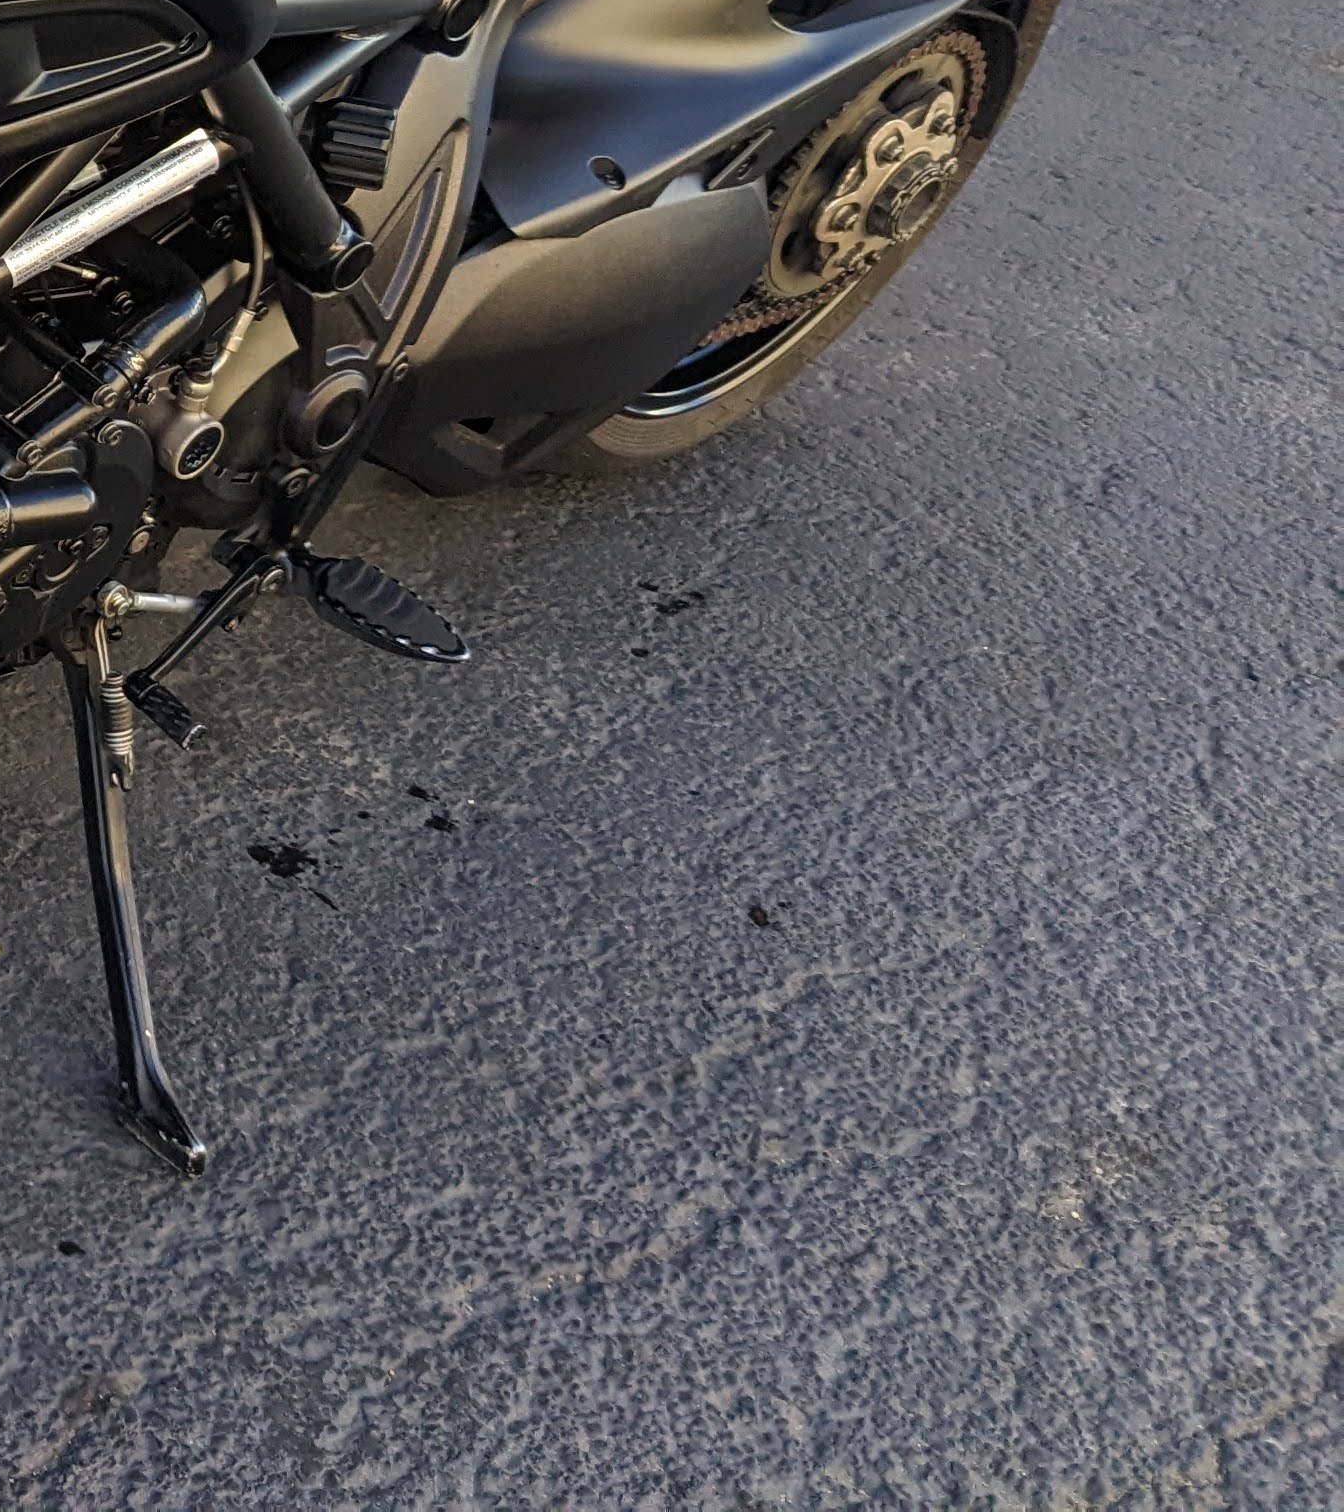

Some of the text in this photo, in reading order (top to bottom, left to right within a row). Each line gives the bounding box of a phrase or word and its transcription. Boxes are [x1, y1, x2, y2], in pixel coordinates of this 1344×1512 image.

[10, 138, 199, 251] MOTORCYCLE NOISE EMISSION CONTROL INFORMATION
